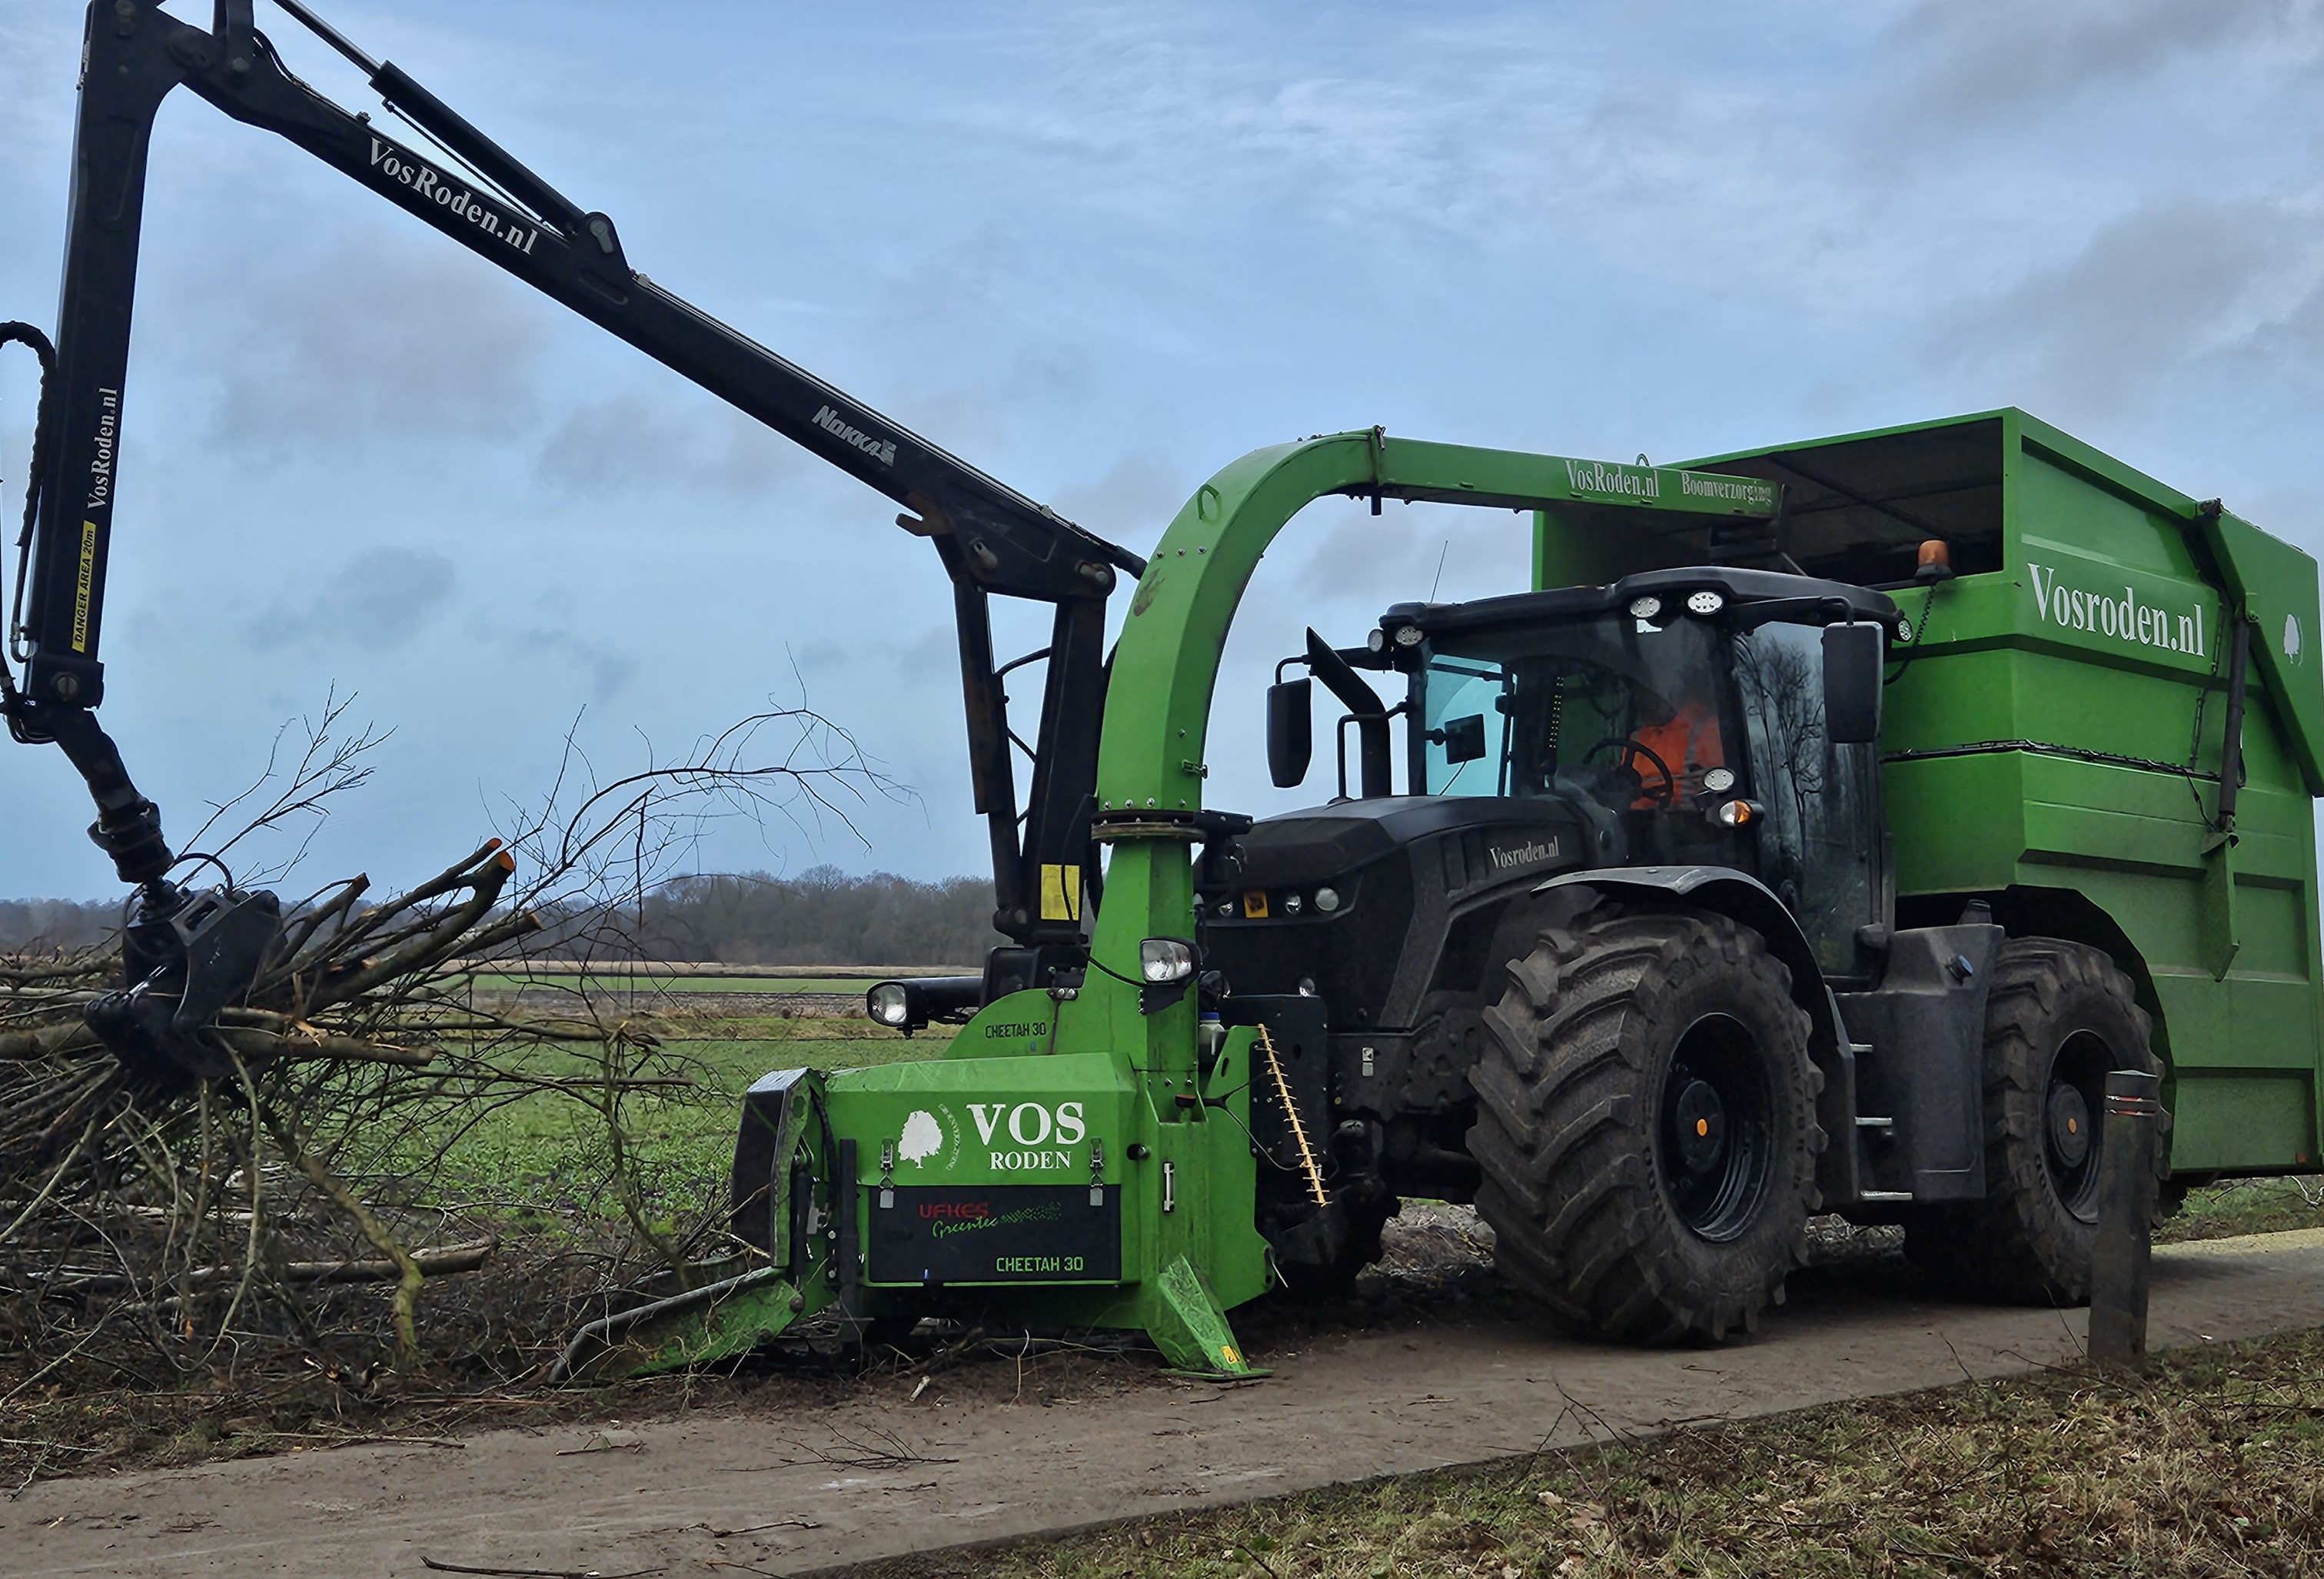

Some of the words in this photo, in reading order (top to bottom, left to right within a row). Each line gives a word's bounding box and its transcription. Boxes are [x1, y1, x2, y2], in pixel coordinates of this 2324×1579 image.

[370, 137, 538, 255] VosRoden.nl
[87, 387, 118, 509] VosRoden.nl
[1564, 460, 1661, 498] VosRoden.nl
[1681, 470, 1772, 505] Boomverzorging
[83, 530, 94, 555] 20m
[79, 557, 91, 590] AREA
[74, 593, 88, 643] DANGER
[2027, 563, 2205, 657] Vosroden.nl
[1489, 836, 1560, 869] Vosroden.nl
[985, 1023, 1030, 1039] CHEETAH
[1032, 1022, 1046, 1036] 30
[966, 1102, 1086, 1145] VOS
[989, 1150, 1072, 1170] RODEN
[919, 1202, 989, 1219] UFKES
[996, 1256, 1060, 1272] CHEETAH
[1063, 1255, 1084, 1272] 30
